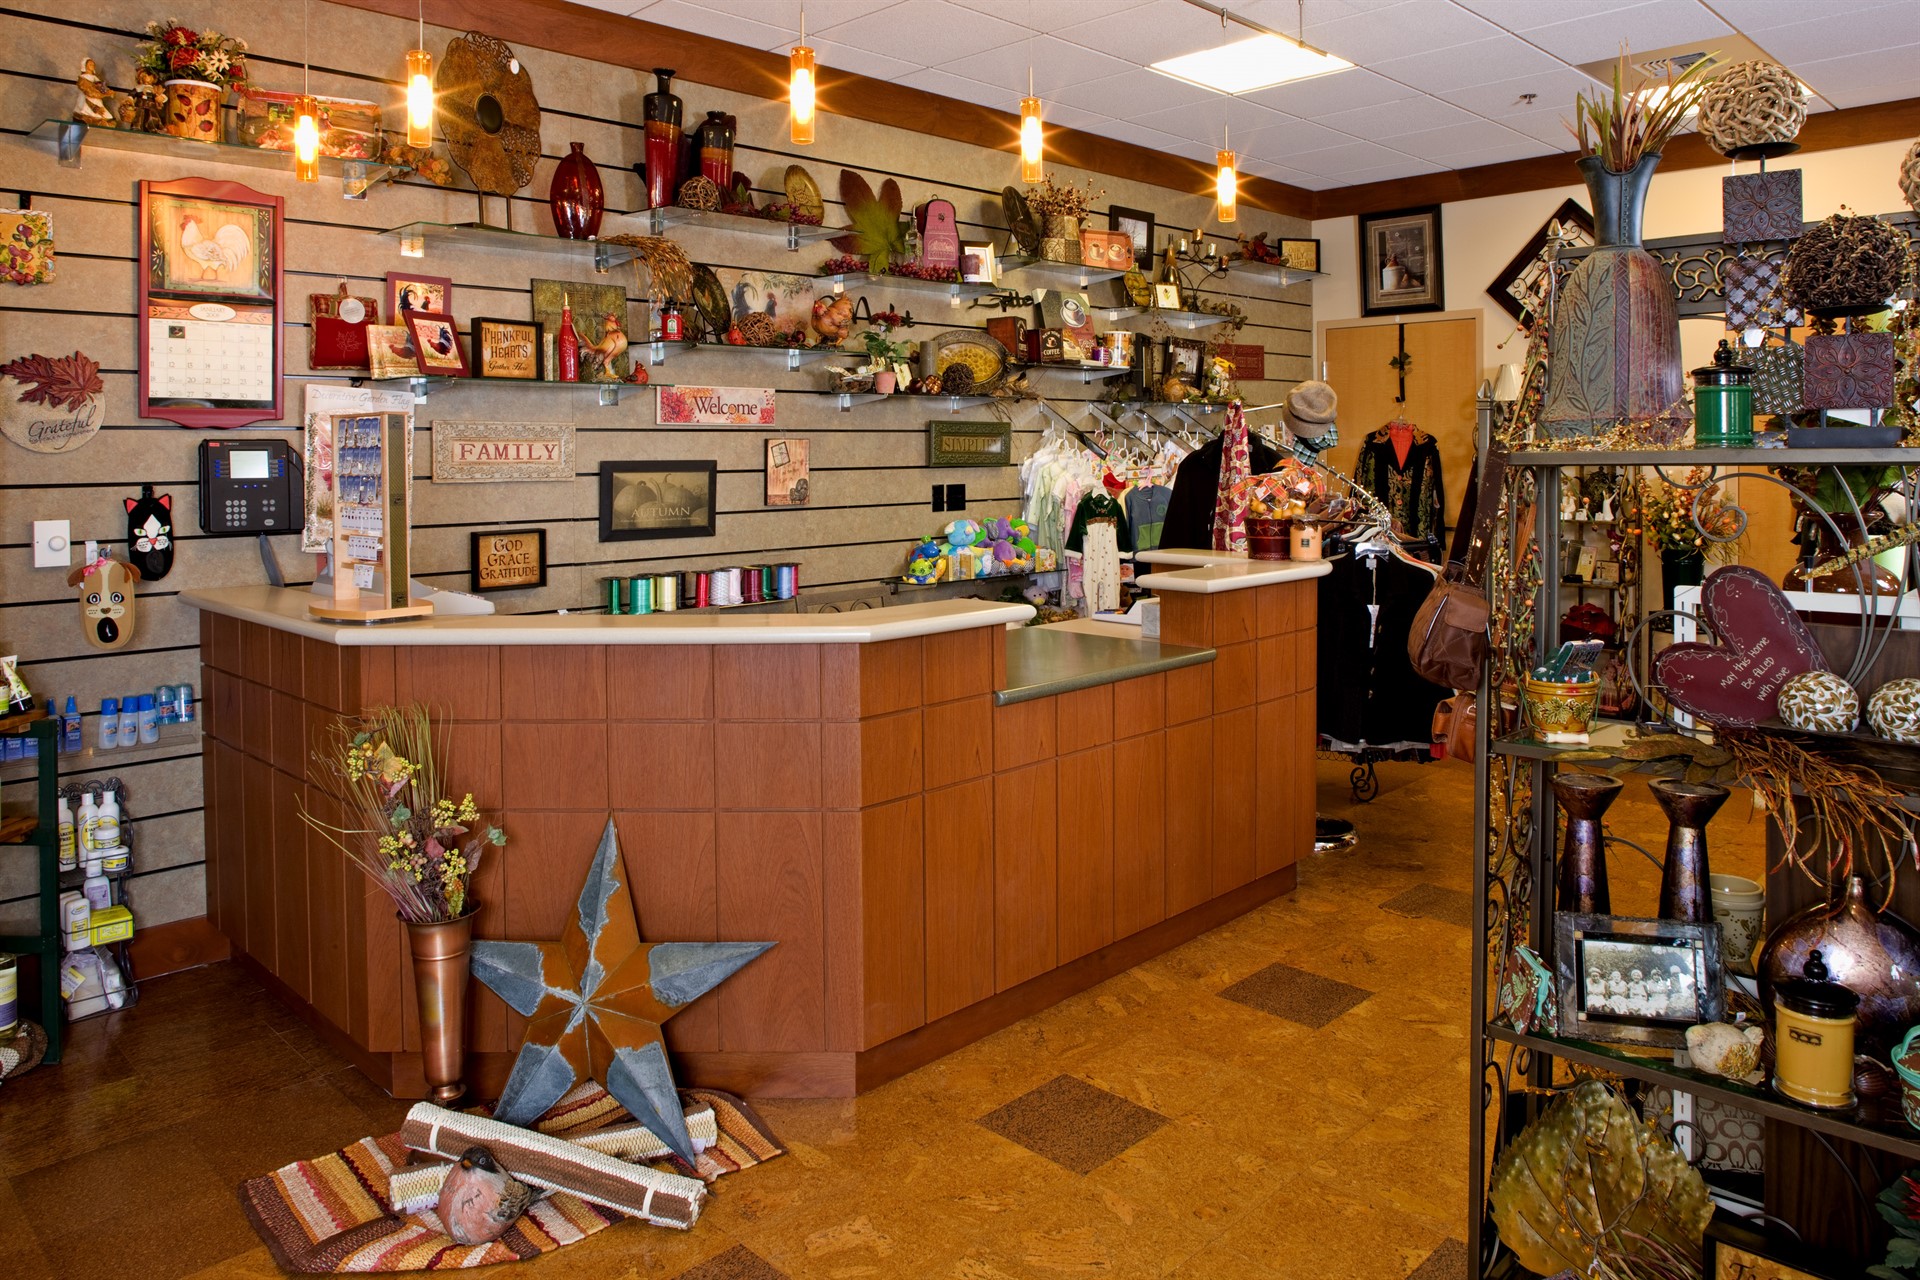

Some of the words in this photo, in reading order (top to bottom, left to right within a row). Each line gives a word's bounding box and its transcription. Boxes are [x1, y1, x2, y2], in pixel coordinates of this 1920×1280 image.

[482, 327, 533, 345] THANKFUL
[491, 344, 528, 359] HEARTS
[1043, 348, 1061, 356] COFFEE
[488, 361, 510, 372] Gather
[512, 361, 529, 371] Here
[312, 388, 357, 400] Decorative
[359, 392, 389, 406] Garden
[391, 393, 411, 409] Flag
[693, 395, 758, 416] Welcome
[28, 404, 97, 450] Grateful
[459, 443, 558, 461] FAMILY
[631, 506, 691, 518] AUTUMN
[494, 538, 523, 553] GOD
[487, 553, 530, 567] GRACE
[480, 565, 538, 580] GRATITUDE
[1732, 656, 1751, 672] this
[1741, 677, 1756, 690] Be
[1756, 684, 1775, 701] with
[1769, 666, 1790, 684] Love
